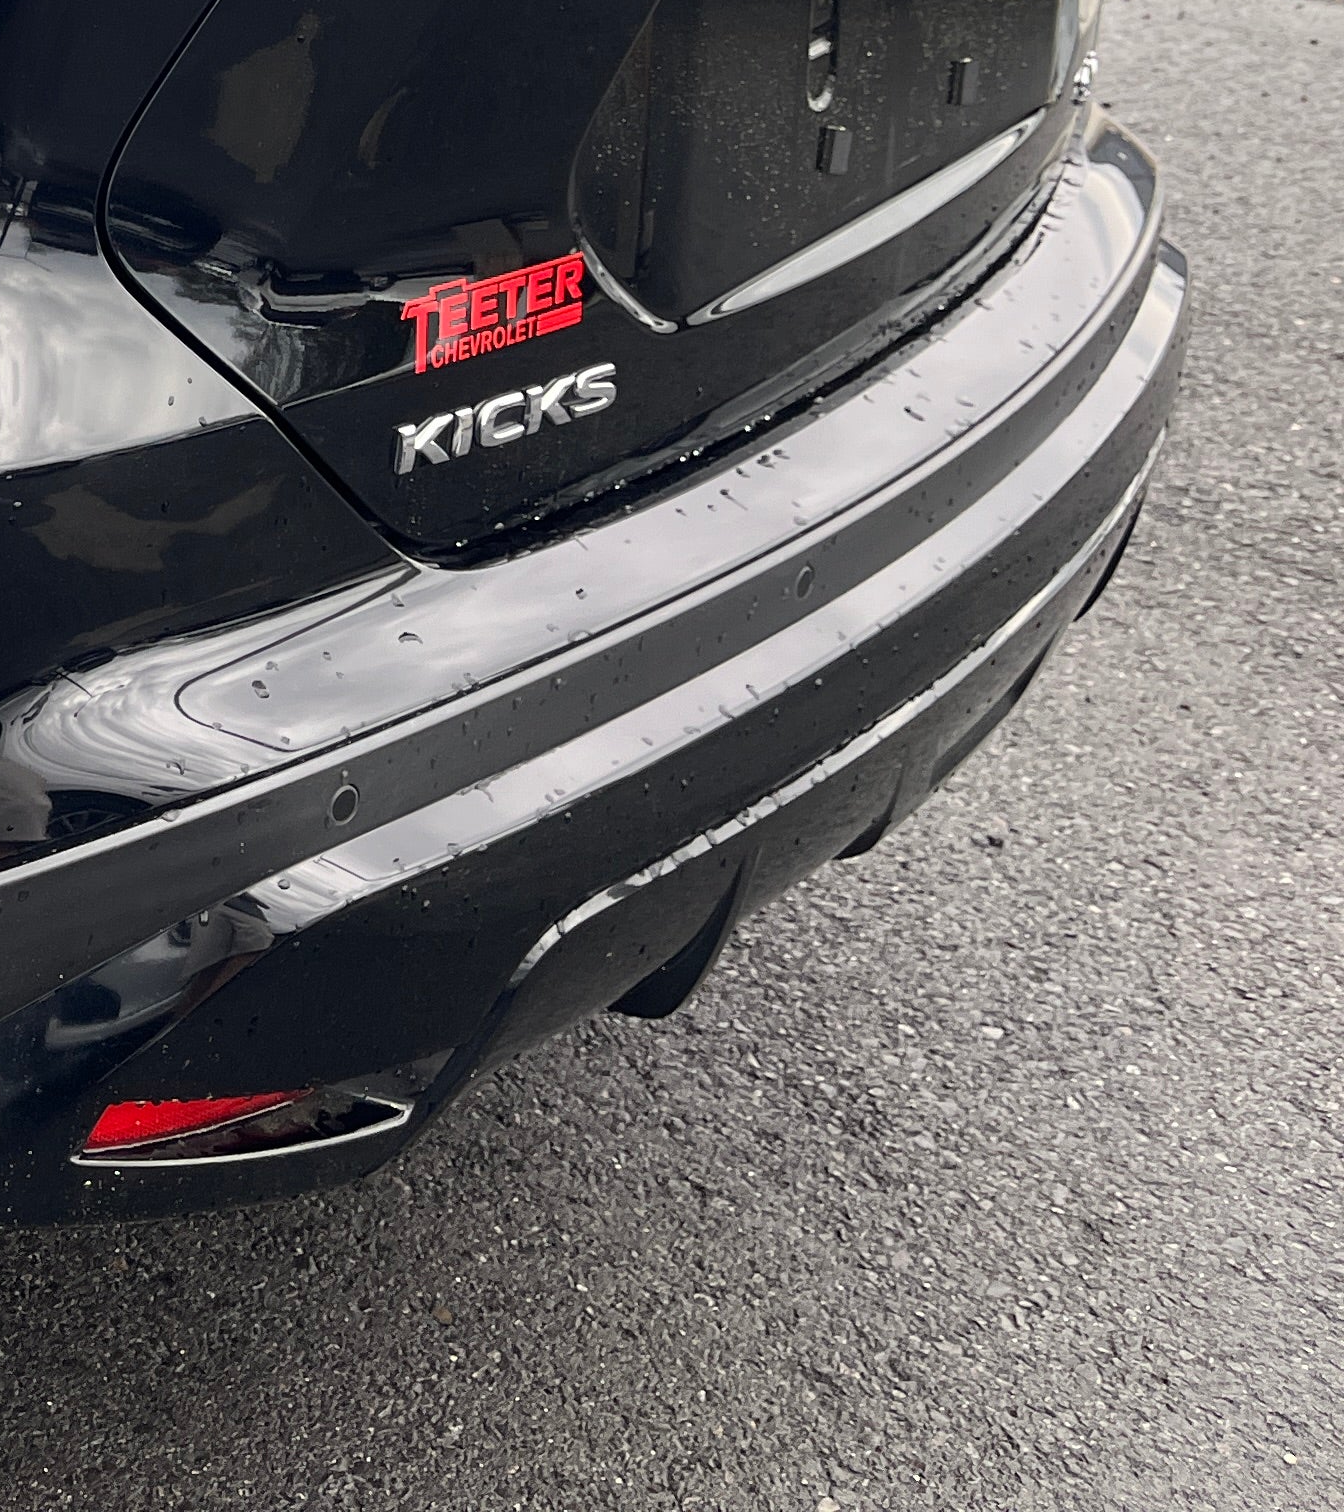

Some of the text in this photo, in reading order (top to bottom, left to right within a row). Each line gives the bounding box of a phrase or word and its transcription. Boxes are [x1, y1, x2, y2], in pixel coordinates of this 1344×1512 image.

[402, 254, 584, 373] TEETER
[431, 317, 539, 368] CHEVROLET
[394, 363, 616, 475] KICKS
